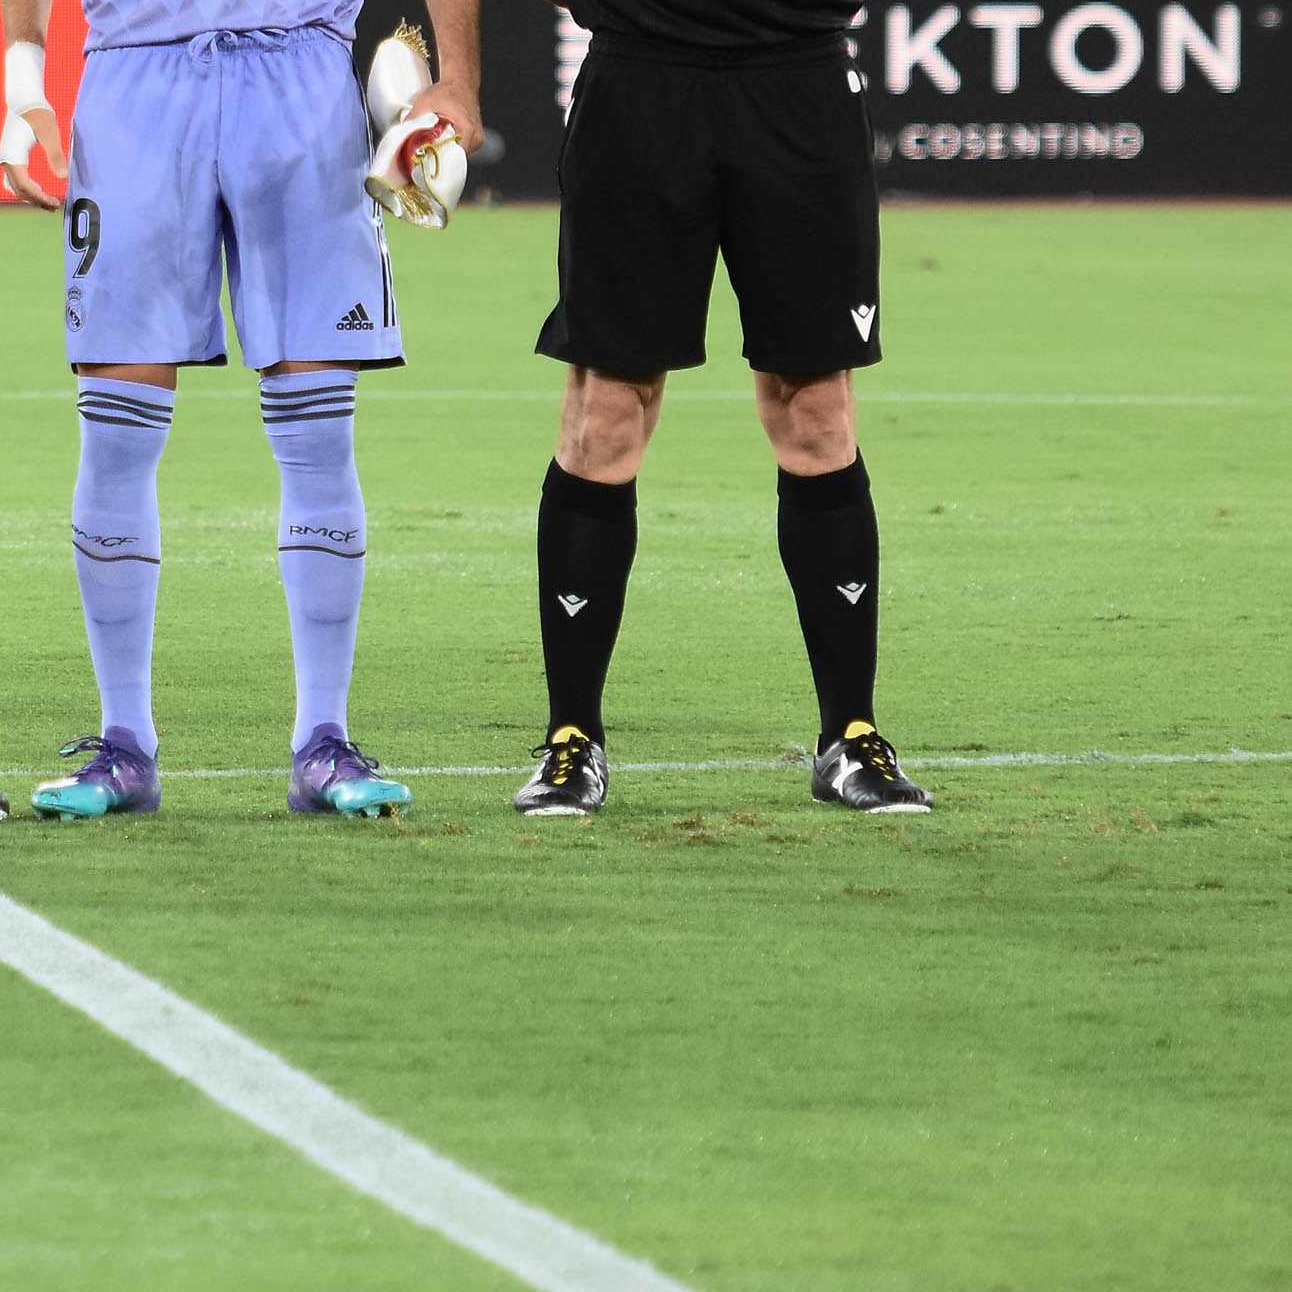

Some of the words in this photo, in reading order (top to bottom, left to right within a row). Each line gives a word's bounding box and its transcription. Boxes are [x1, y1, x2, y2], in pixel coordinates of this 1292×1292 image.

[69, 197, 102, 279] 9
[335, 320, 375, 331] adidas
[289, 525, 359, 543] RMCF
